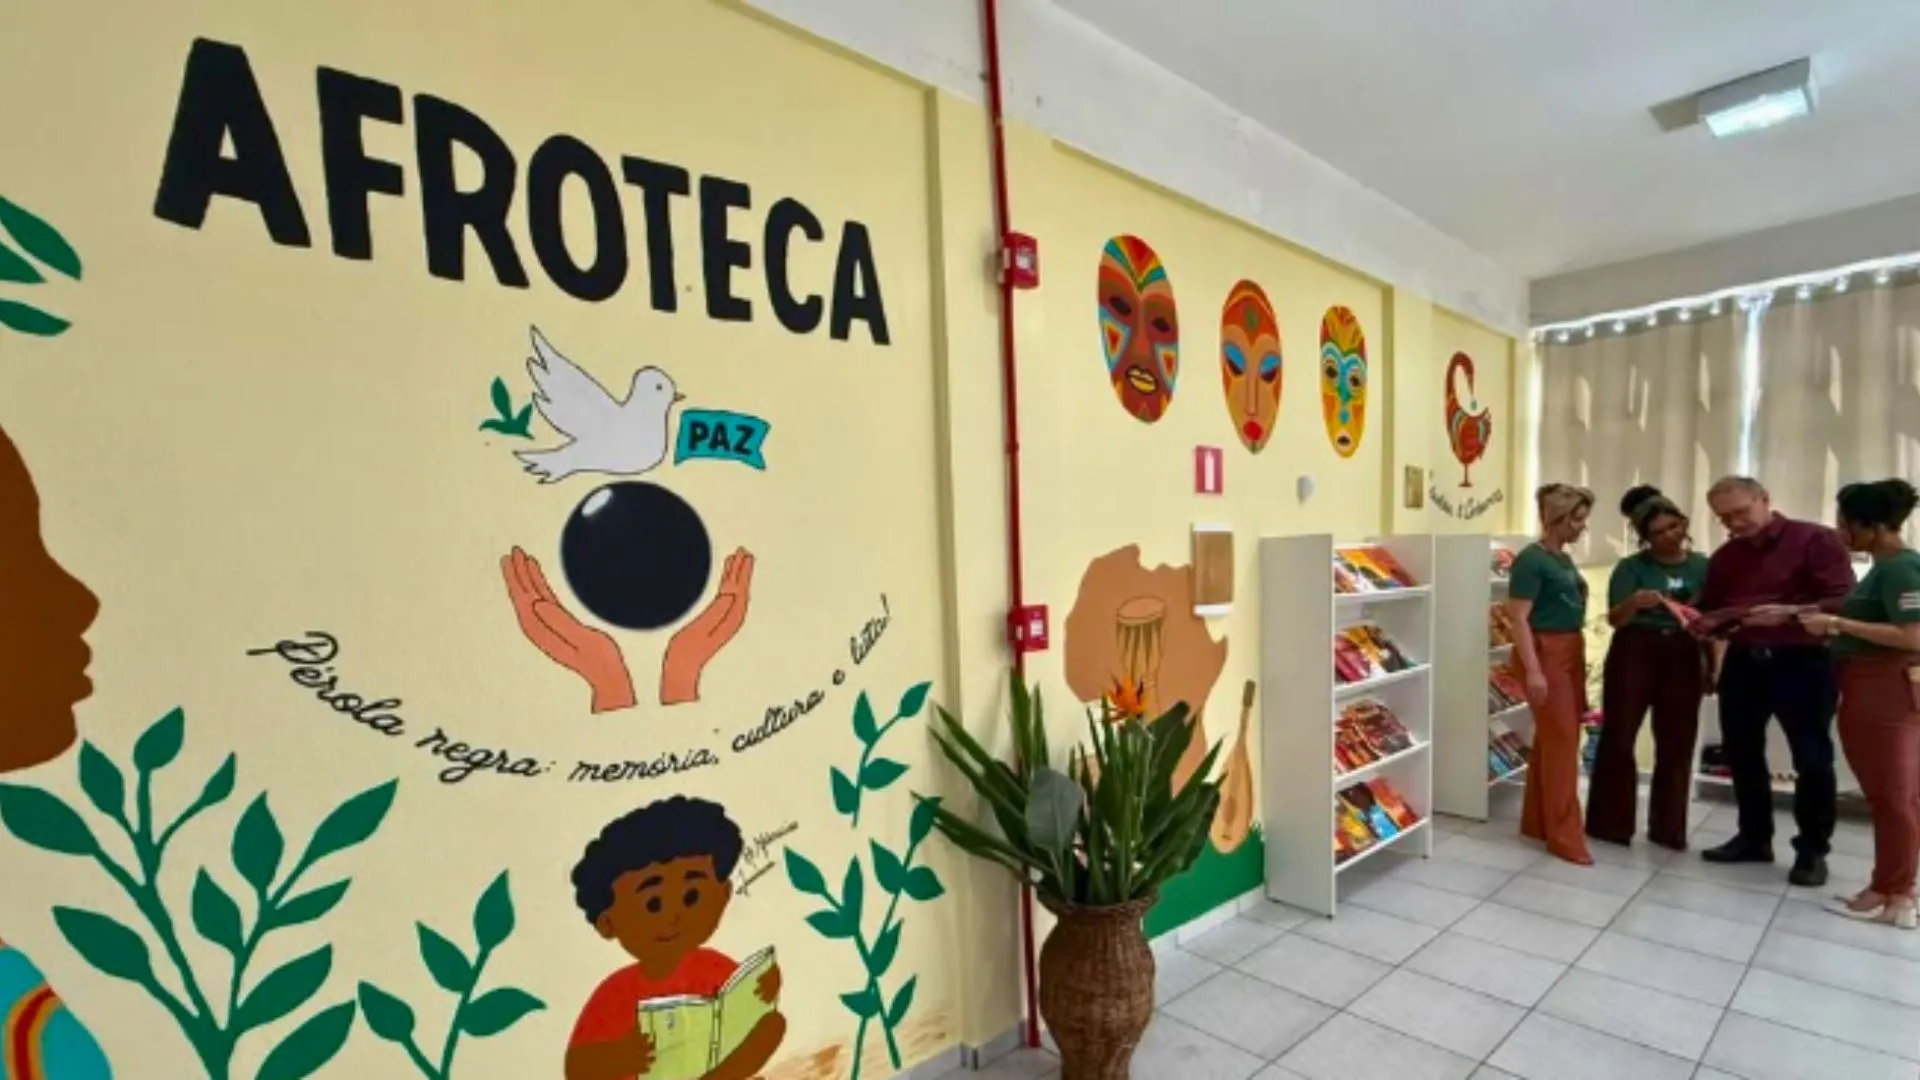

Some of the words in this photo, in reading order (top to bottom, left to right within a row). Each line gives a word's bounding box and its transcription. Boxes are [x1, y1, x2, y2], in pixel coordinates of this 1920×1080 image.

[153, 36, 891, 347] AFROTECA
[688, 420, 756, 456] PAZ
[245, 630, 405, 736] Pérola
[414, 726, 556, 784] negra:
[731, 689, 826, 753] cultura
[831, 668, 846, 686] e
[849, 592, 892, 666] luta!
